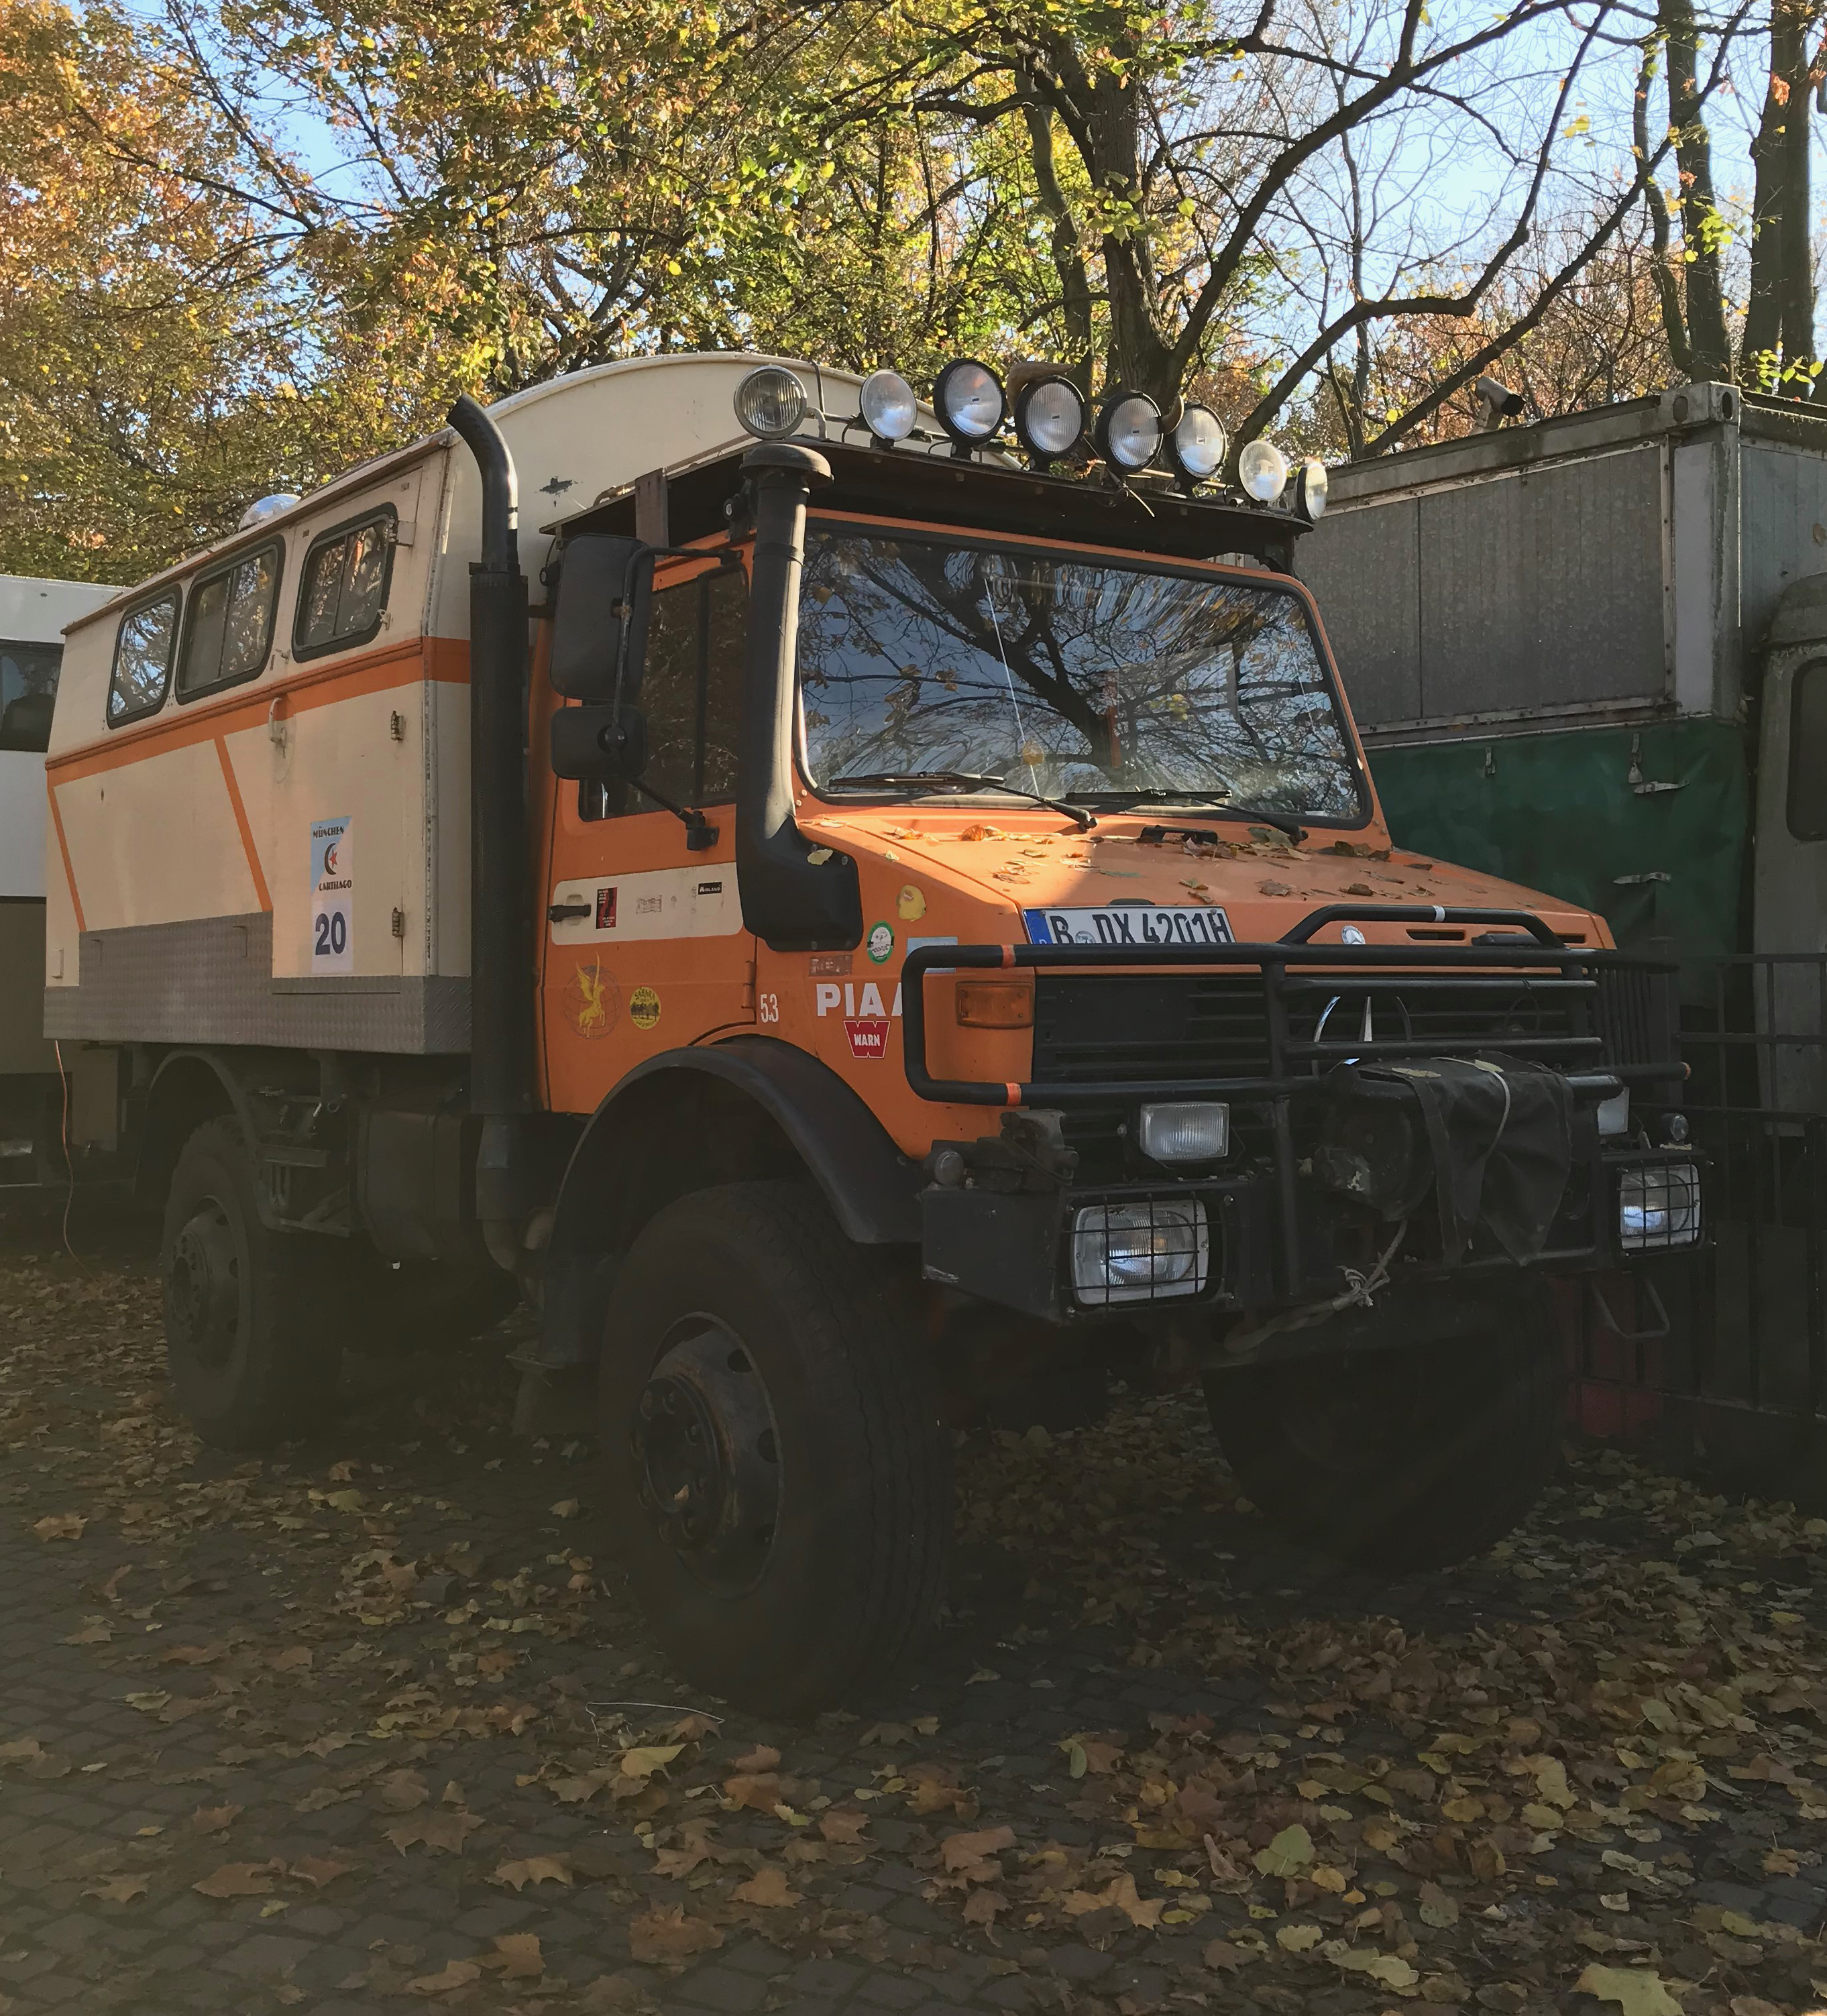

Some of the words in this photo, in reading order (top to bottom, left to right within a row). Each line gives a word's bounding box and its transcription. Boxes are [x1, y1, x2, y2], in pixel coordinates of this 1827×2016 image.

[313, 826, 345, 839] MÜNCHEN
[319, 879, 352, 891] CARTHAGO
[315, 911, 347, 955] 20
[1050, 915, 1074, 944] B
[1092, 913, 1134, 943] DX
[1143, 913, 1231, 943] 4201H
[854, 1033, 880, 1046] WARN
